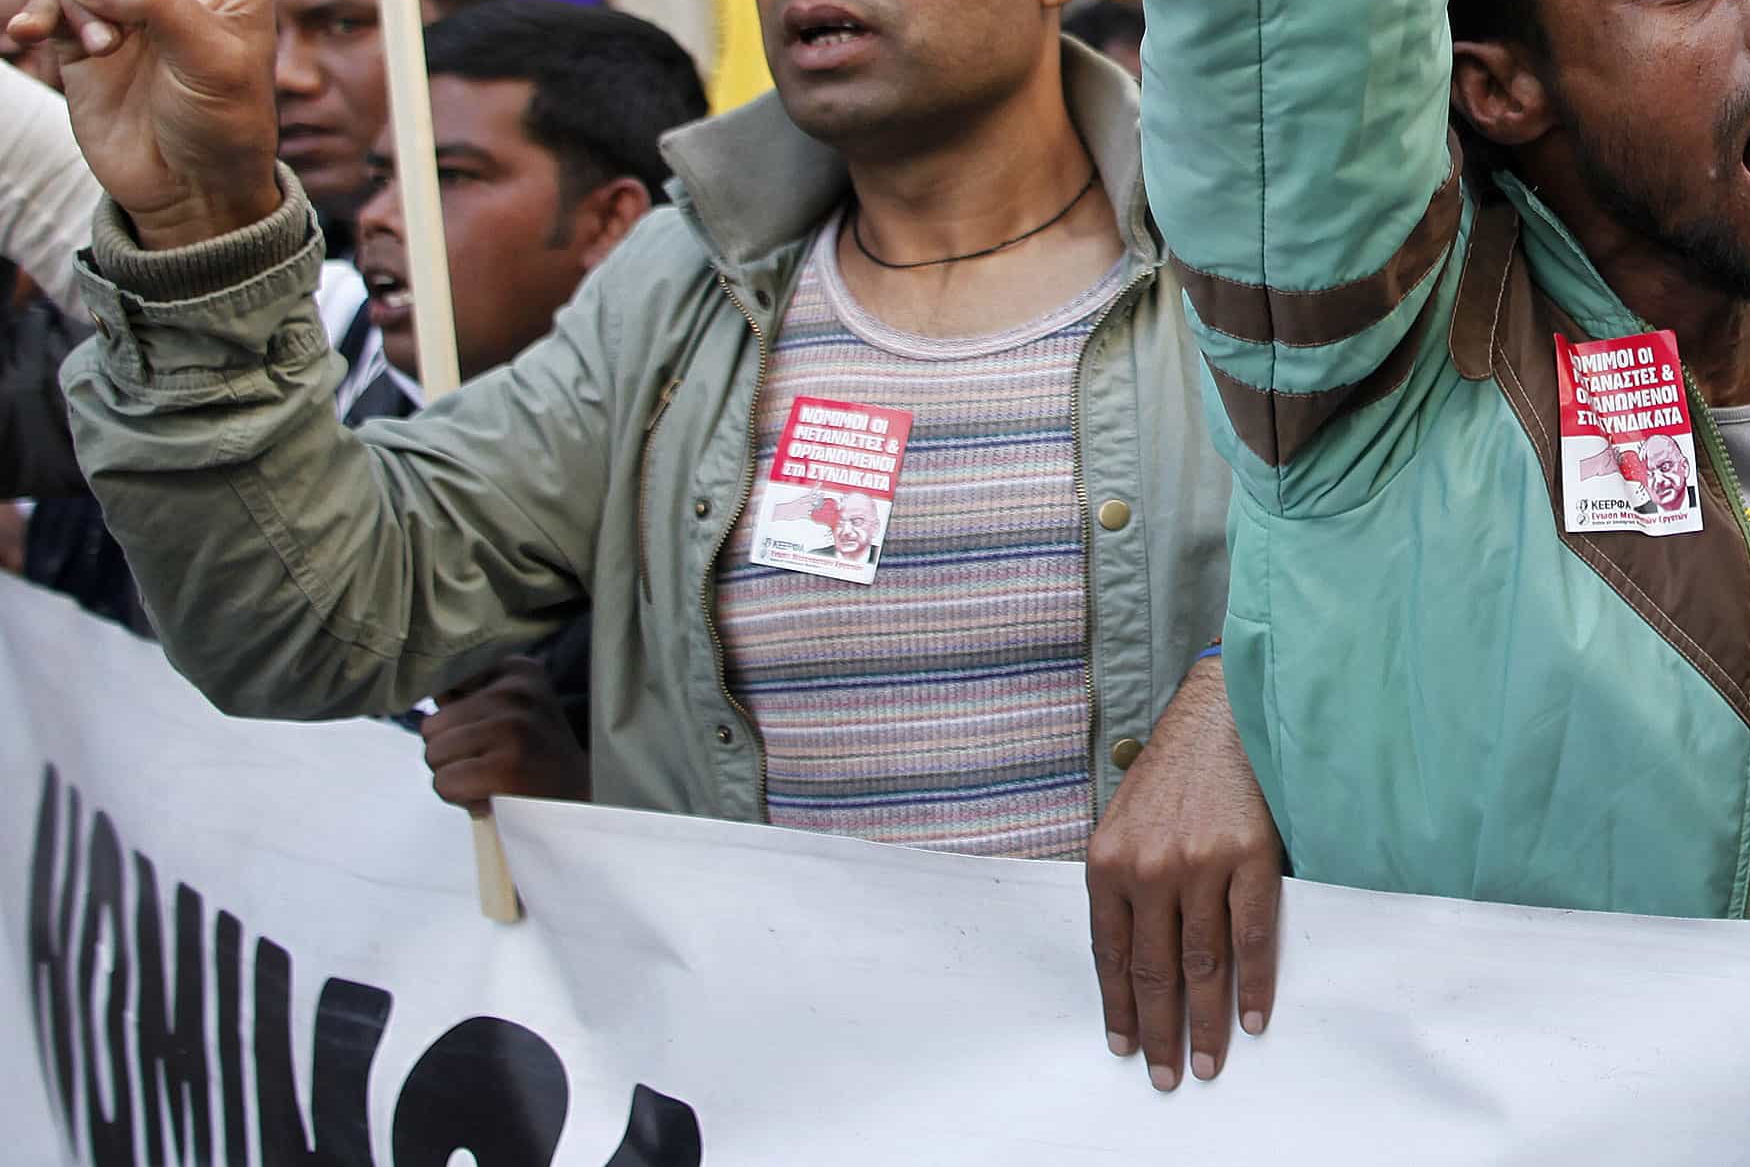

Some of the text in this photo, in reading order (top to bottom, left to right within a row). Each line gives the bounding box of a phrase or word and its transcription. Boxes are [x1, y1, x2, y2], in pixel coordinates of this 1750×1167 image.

[1568, 346, 1654, 374] ΟΜΙΜΟΙ ΟΙ
[1662, 364, 1675, 381] &
[1576, 384, 1679, 414] ΟΑΝΩΜΕΝΟΙ
[800, 406, 889, 434] ΝΟΜΙΜΟΙ ΟΙ
[793, 424, 885, 452] ΜΕΤΑΝΑΣΤΕΣ
[782, 461, 806, 477] ΣΤΑ
[1591, 499, 1631, 511] ΚΕΕΡΦΑ
